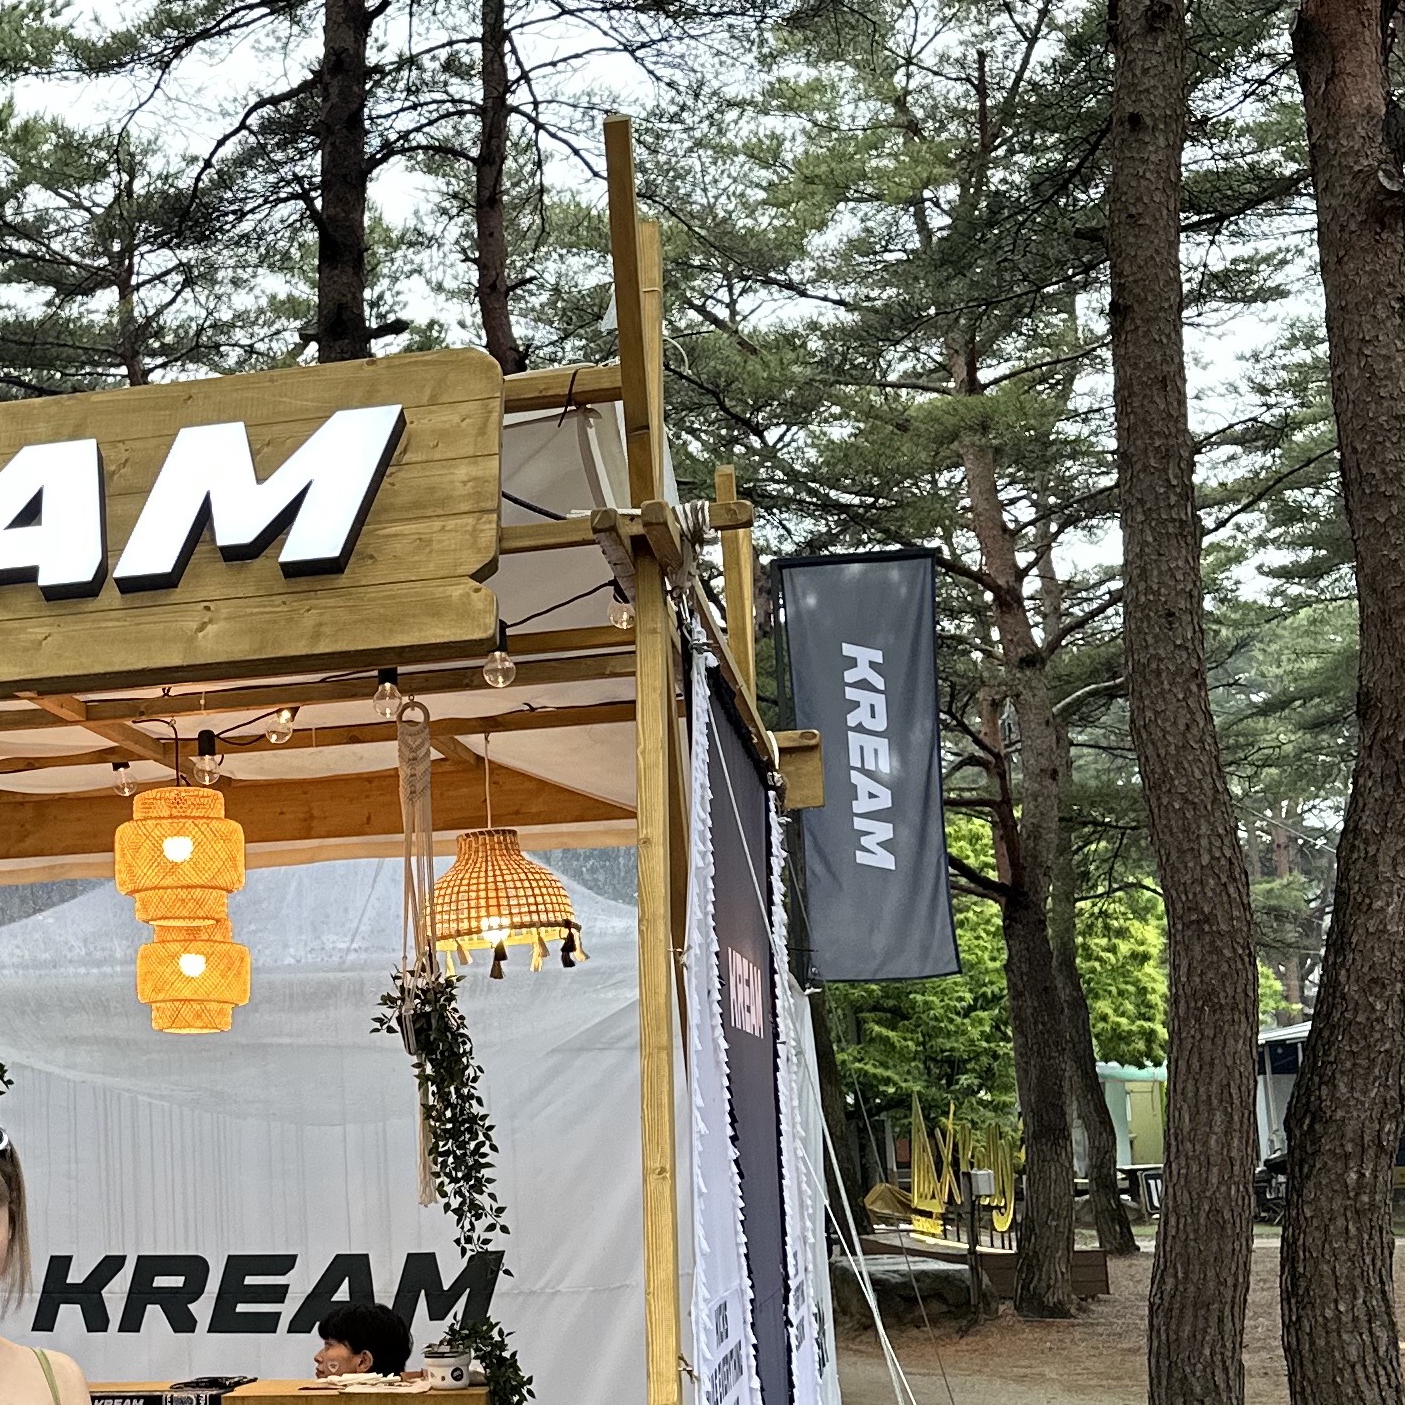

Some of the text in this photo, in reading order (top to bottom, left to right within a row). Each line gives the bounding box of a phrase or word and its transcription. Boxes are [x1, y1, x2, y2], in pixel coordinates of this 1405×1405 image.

[841, 642, 896, 871] KREAM
[727, 946, 764, 1039] KREAM
[31, 1250, 505, 1334] KREAM
